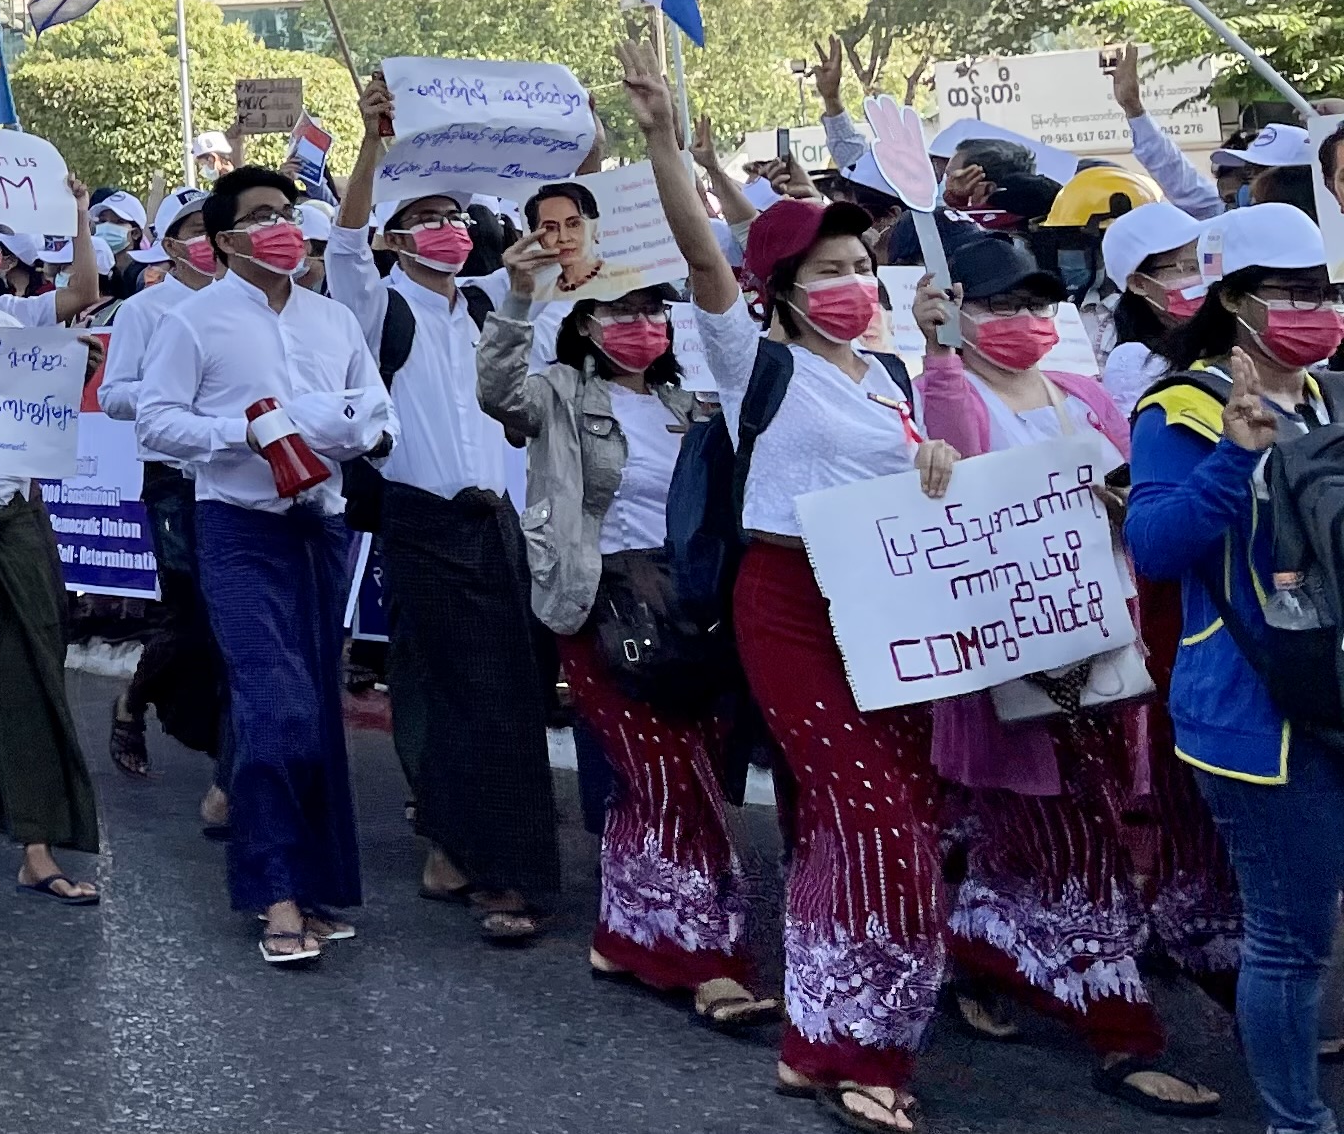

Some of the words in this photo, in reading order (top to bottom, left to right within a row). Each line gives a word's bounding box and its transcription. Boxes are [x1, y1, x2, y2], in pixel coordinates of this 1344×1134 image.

[1184, 123, 1204, 135] 276
[14, 156, 37, 168] us
[101, 517, 142, 540] Union
